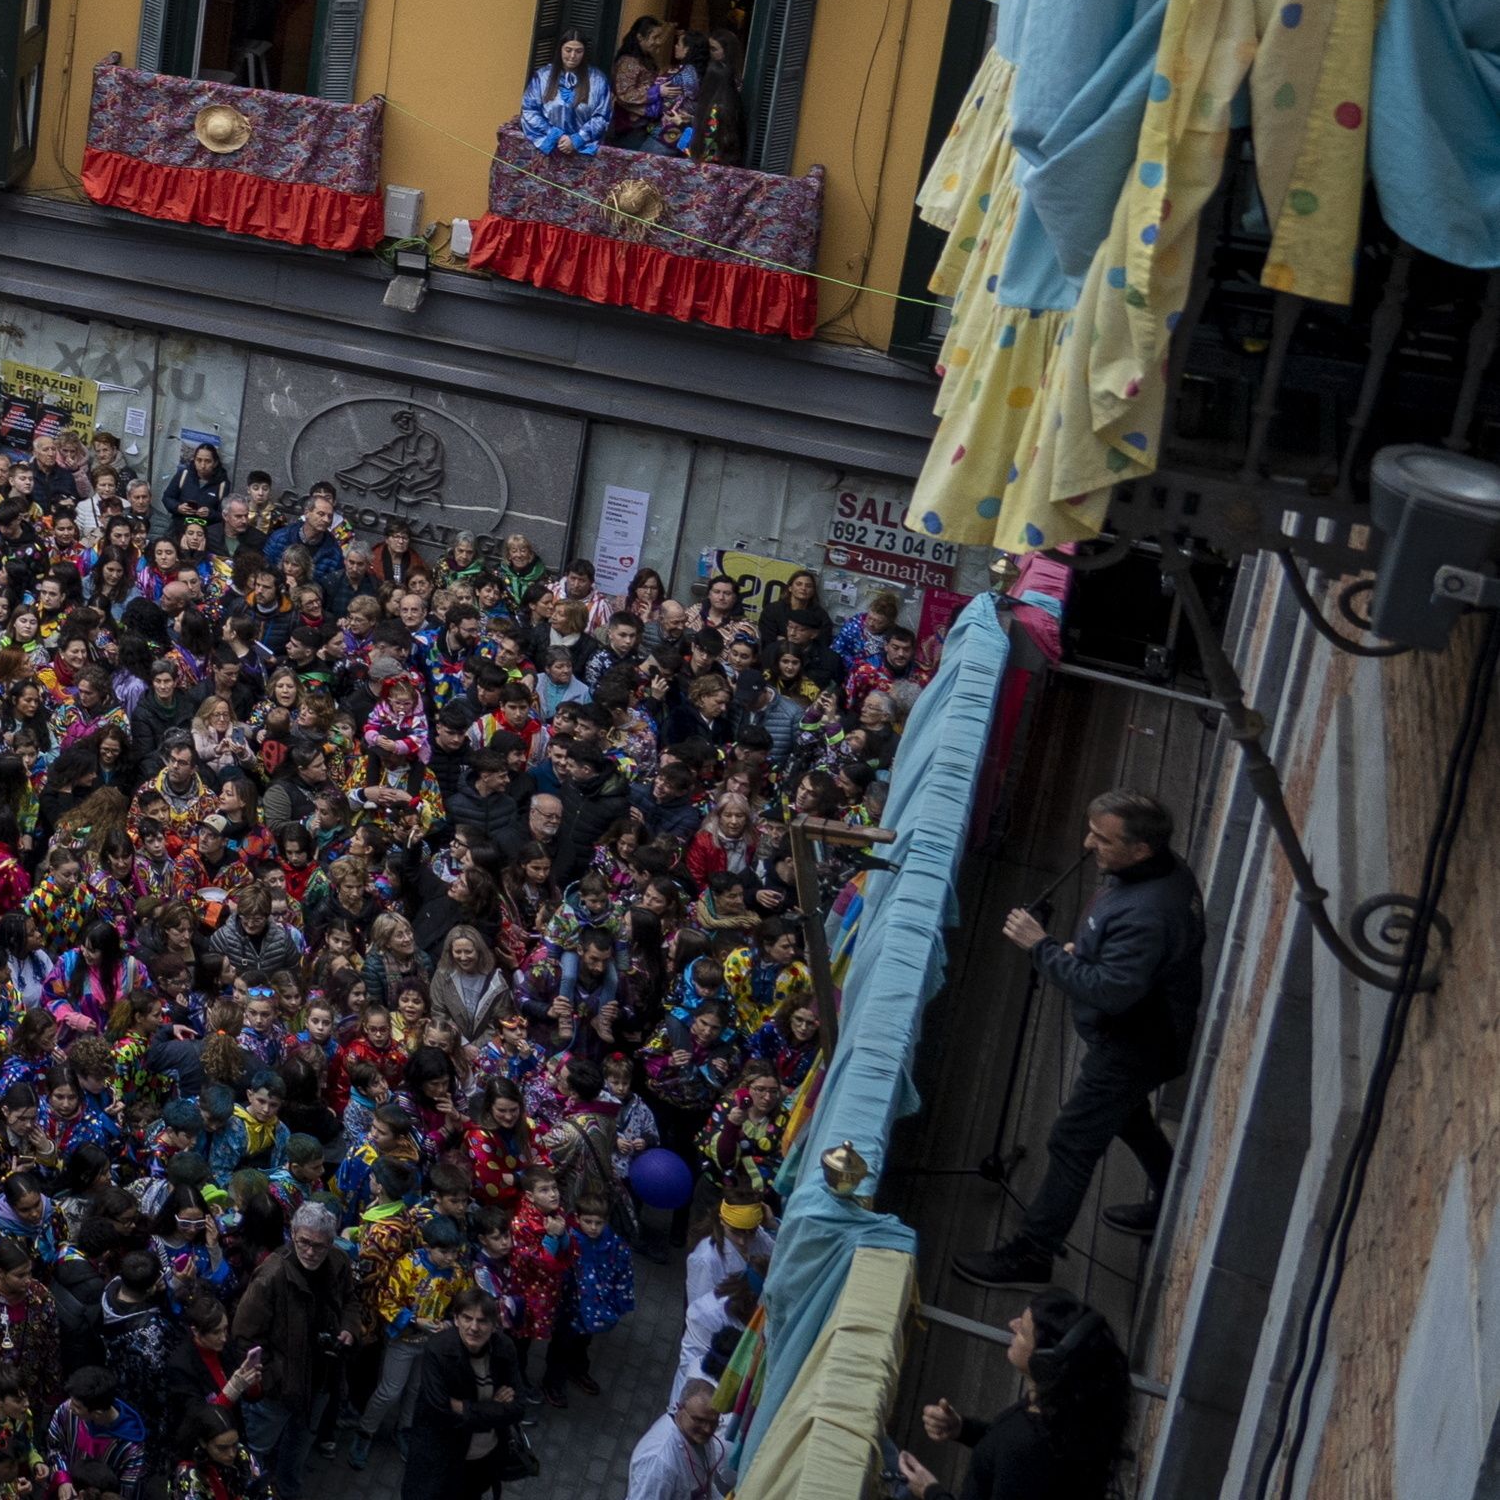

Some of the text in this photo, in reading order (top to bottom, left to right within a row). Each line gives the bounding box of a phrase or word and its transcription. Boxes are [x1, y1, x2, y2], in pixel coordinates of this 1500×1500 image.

[837, 492, 916, 533] SAL
[833, 520, 957, 564] 692 73 04 61
